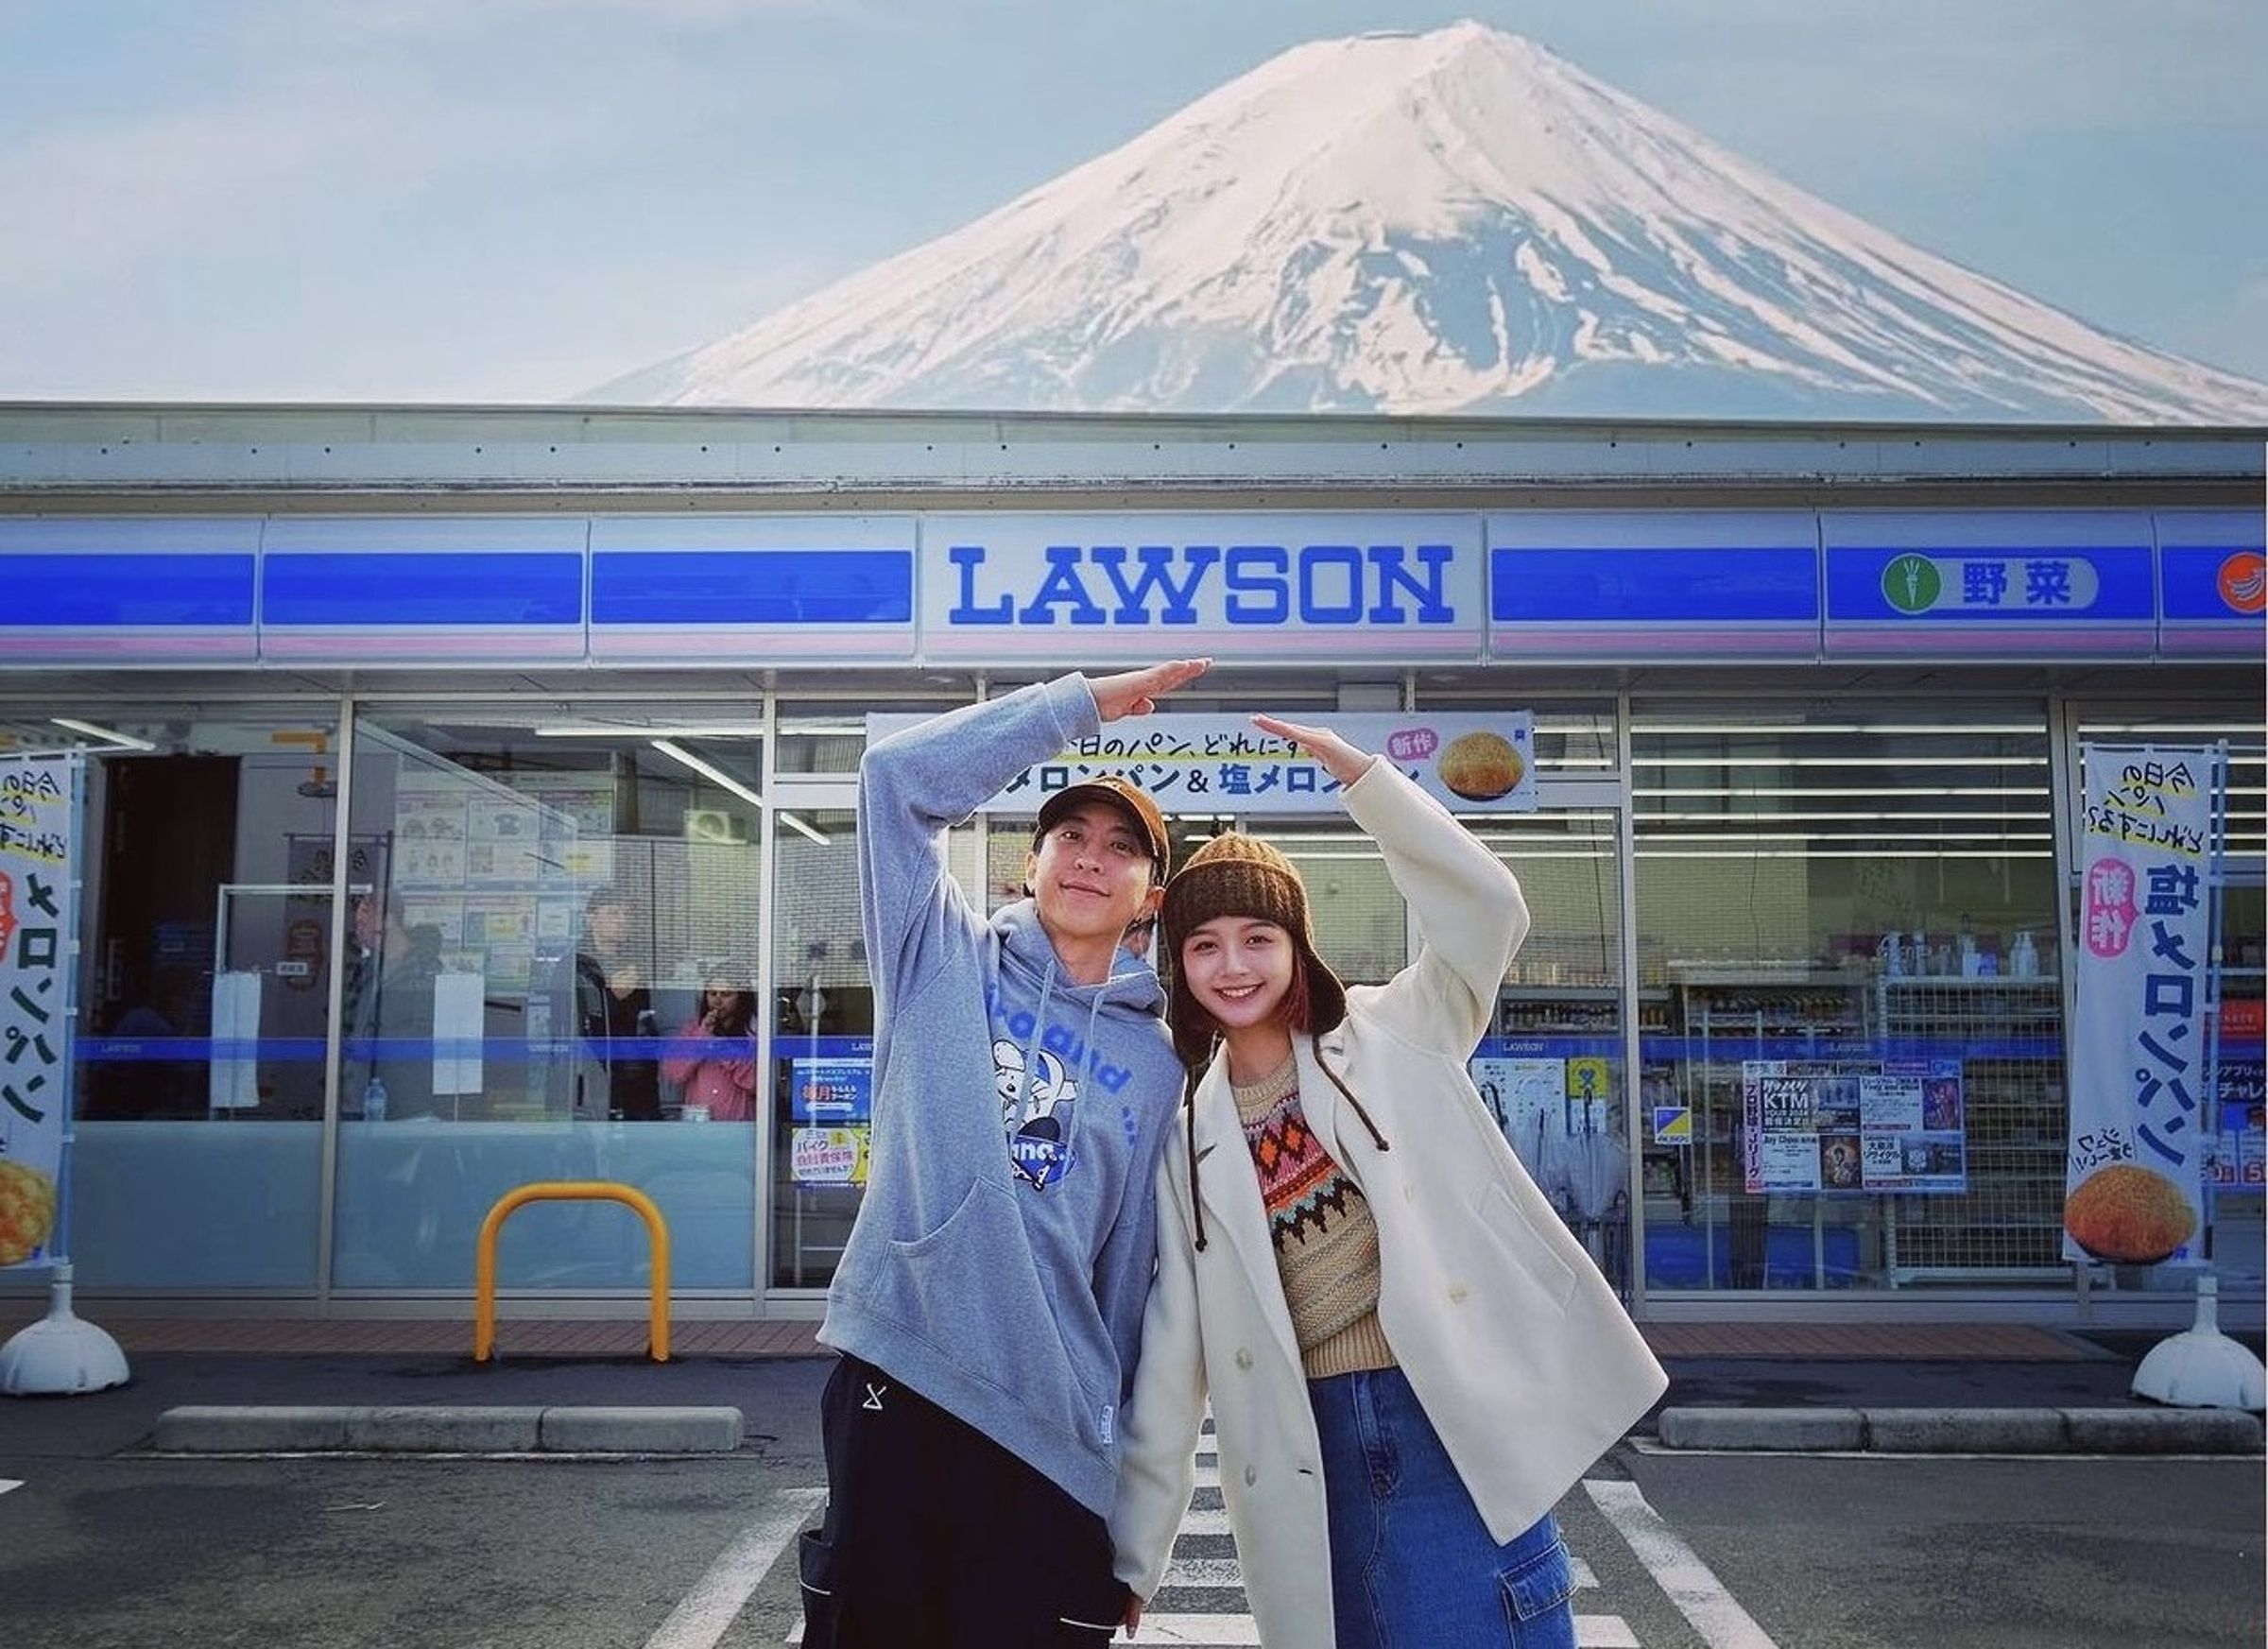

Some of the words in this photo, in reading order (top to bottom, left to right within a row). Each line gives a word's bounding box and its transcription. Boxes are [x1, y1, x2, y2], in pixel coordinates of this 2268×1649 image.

[948, 545, 1455, 626] LAWSON
[1963, 561, 2070, 605] 野菜
[1072, 732, 1298, 759] 日のパン、どれにす
[1391, 732, 1435, 757] 新作
[1187, 769, 1209, 794] &
[1503, 1042, 1544, 1052] LAWSON
[1764, 1092, 1809, 1109] KTM
[797, 1140, 828, 1152] バイク
